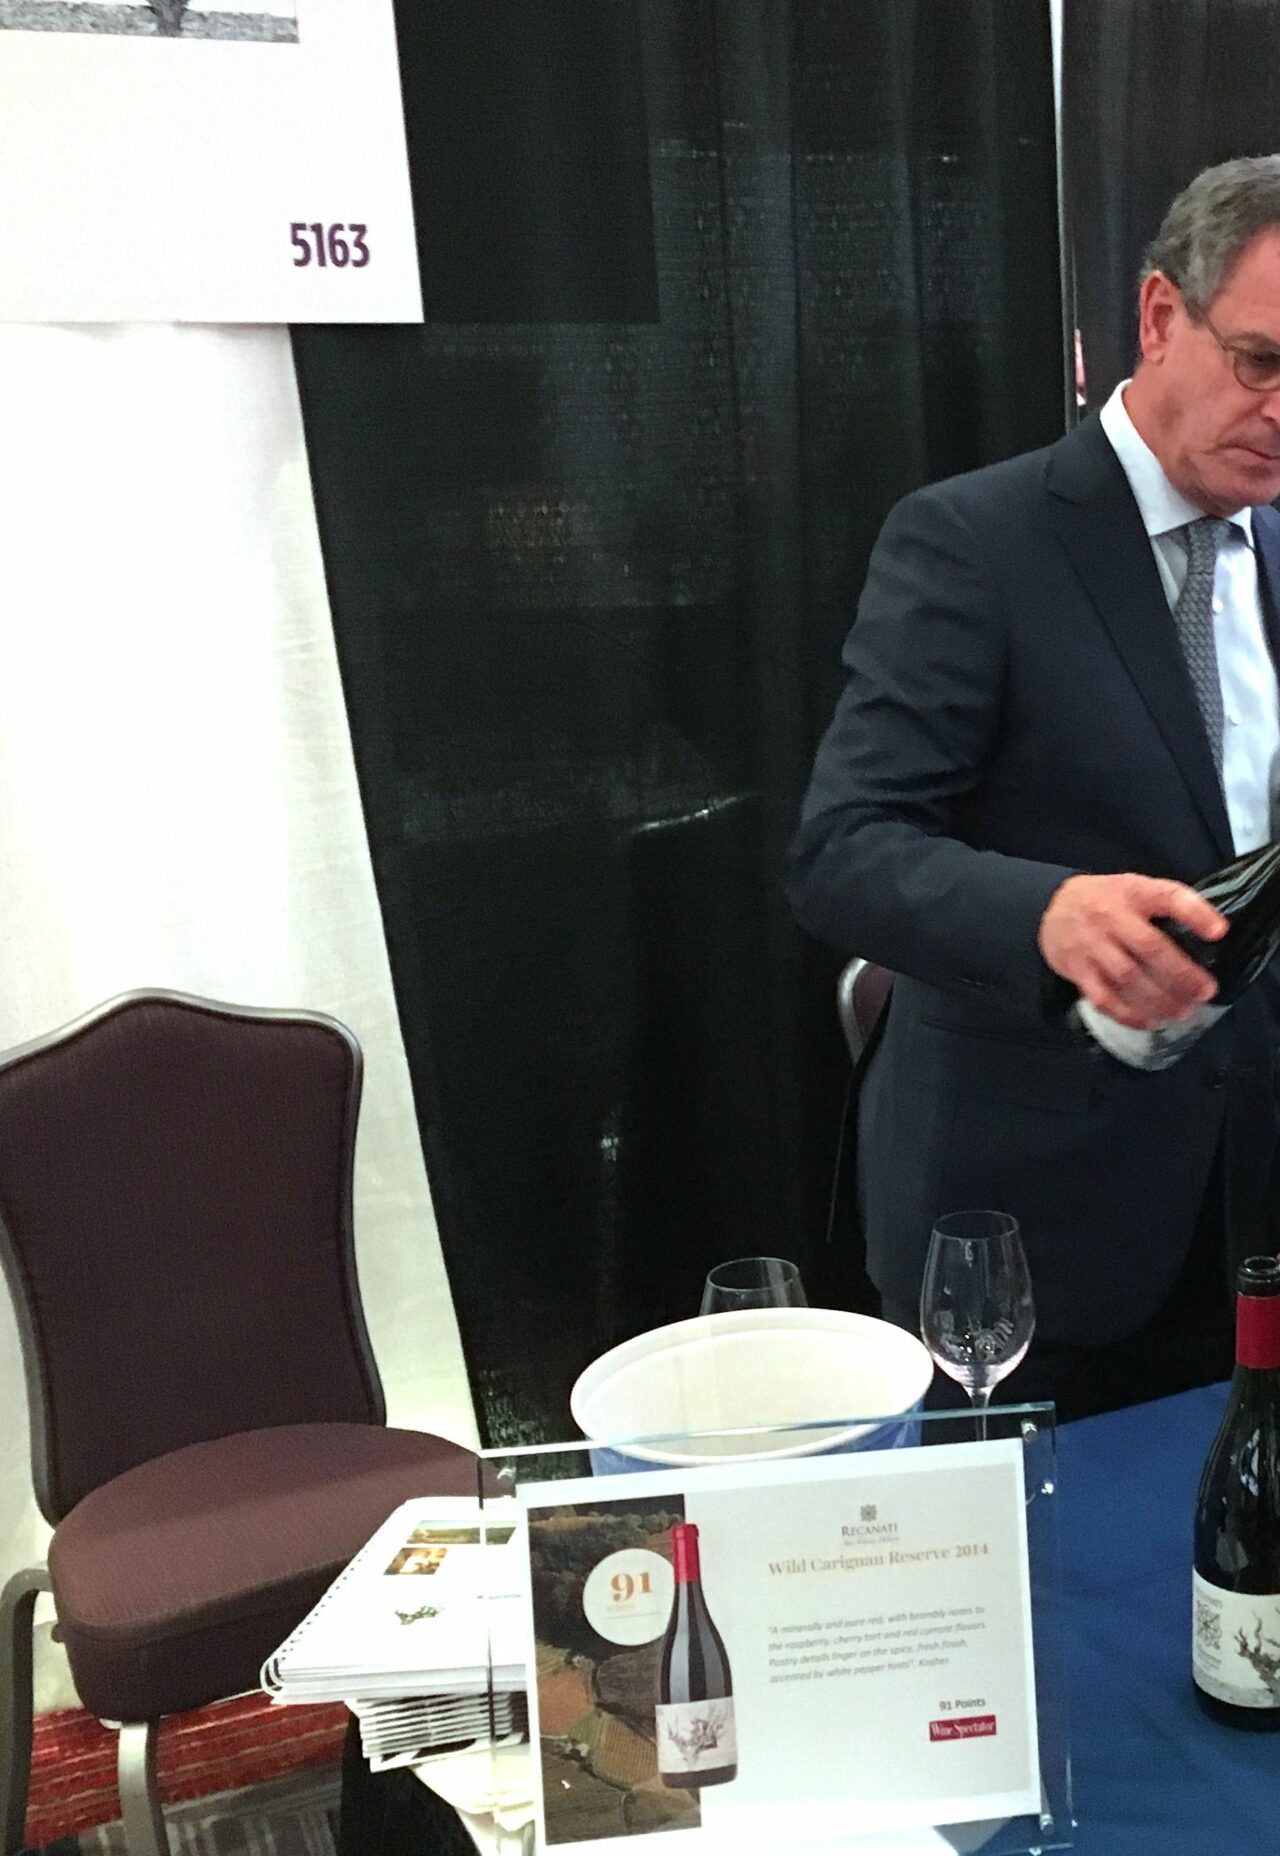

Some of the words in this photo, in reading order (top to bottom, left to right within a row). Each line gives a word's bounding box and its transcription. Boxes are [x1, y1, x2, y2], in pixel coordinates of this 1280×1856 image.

[290, 222, 370, 268] 5163
[841, 1523, 898, 1537] RECANATI
[768, 1558, 806, 1576] Wild
[811, 1552, 884, 1572] Carignan
[889, 1545, 951, 1564] Reserve
[955, 1543, 989, 1557] 2014
[611, 1571, 652, 1602] 91
[825, 1618, 843, 1629] and
[888, 1613, 907, 1623] with
[975, 1606, 985, 1615] to
[768, 1642, 783, 1652] the
[883, 1630, 901, 1640] and
[903, 1627, 919, 1637] red
[859, 1649, 872, 1659] on
[873, 1647, 888, 1657] the
[813, 1669, 825, 1680] by
[939, 1701, 952, 1711] 91
[955, 1698, 986, 1709] Points
